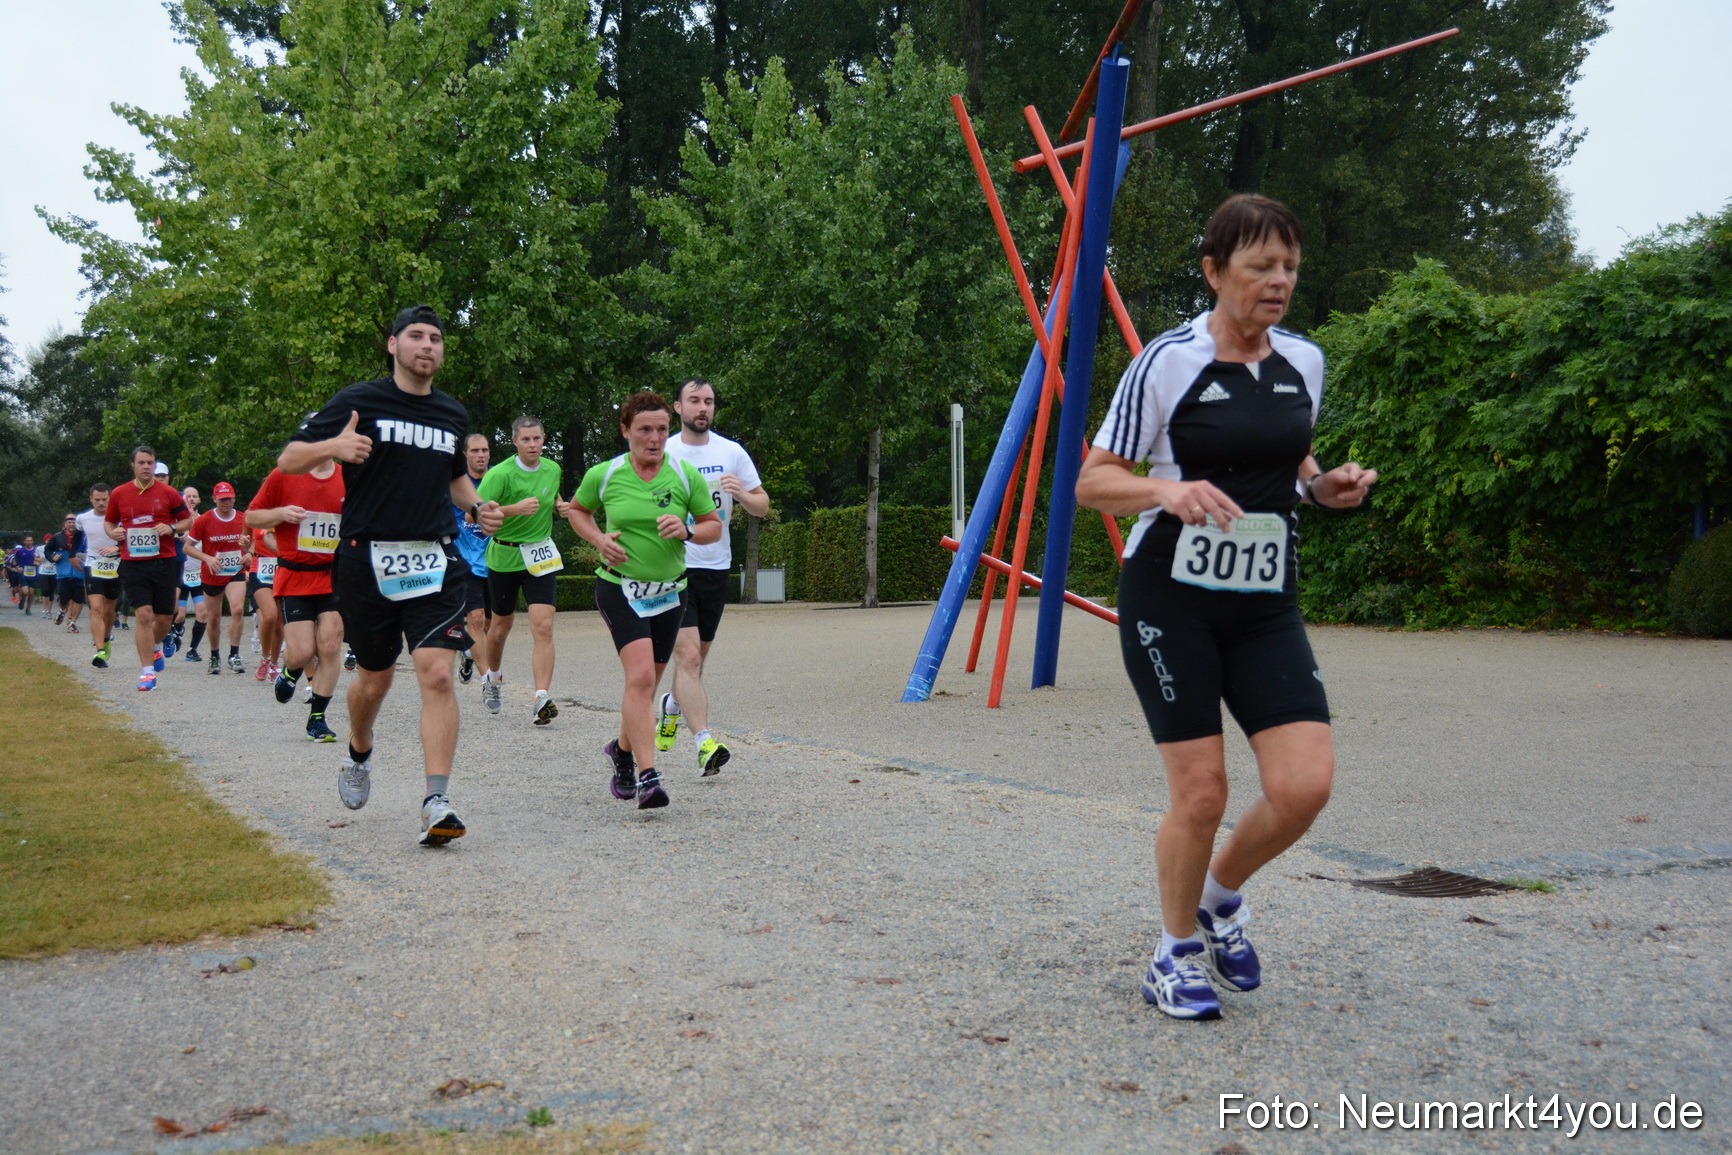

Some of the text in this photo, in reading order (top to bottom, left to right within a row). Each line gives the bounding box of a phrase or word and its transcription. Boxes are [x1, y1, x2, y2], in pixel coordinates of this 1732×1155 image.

[1199, 391, 1231, 402] adidas
[376, 420, 458, 455] THULE
[310, 522, 336, 538] 116
[130, 535, 157, 546] 2623
[220, 556, 240, 567] 2352
[531, 546, 553, 563] 205
[1186, 535, 1279, 582] 3013
[261, 564, 277, 574] 28
[381, 553, 442, 576] 2332
[185, 573, 201, 582] 257
[400, 576, 433, 589] Patrick
[1148, 647, 1176, 702] odlo
